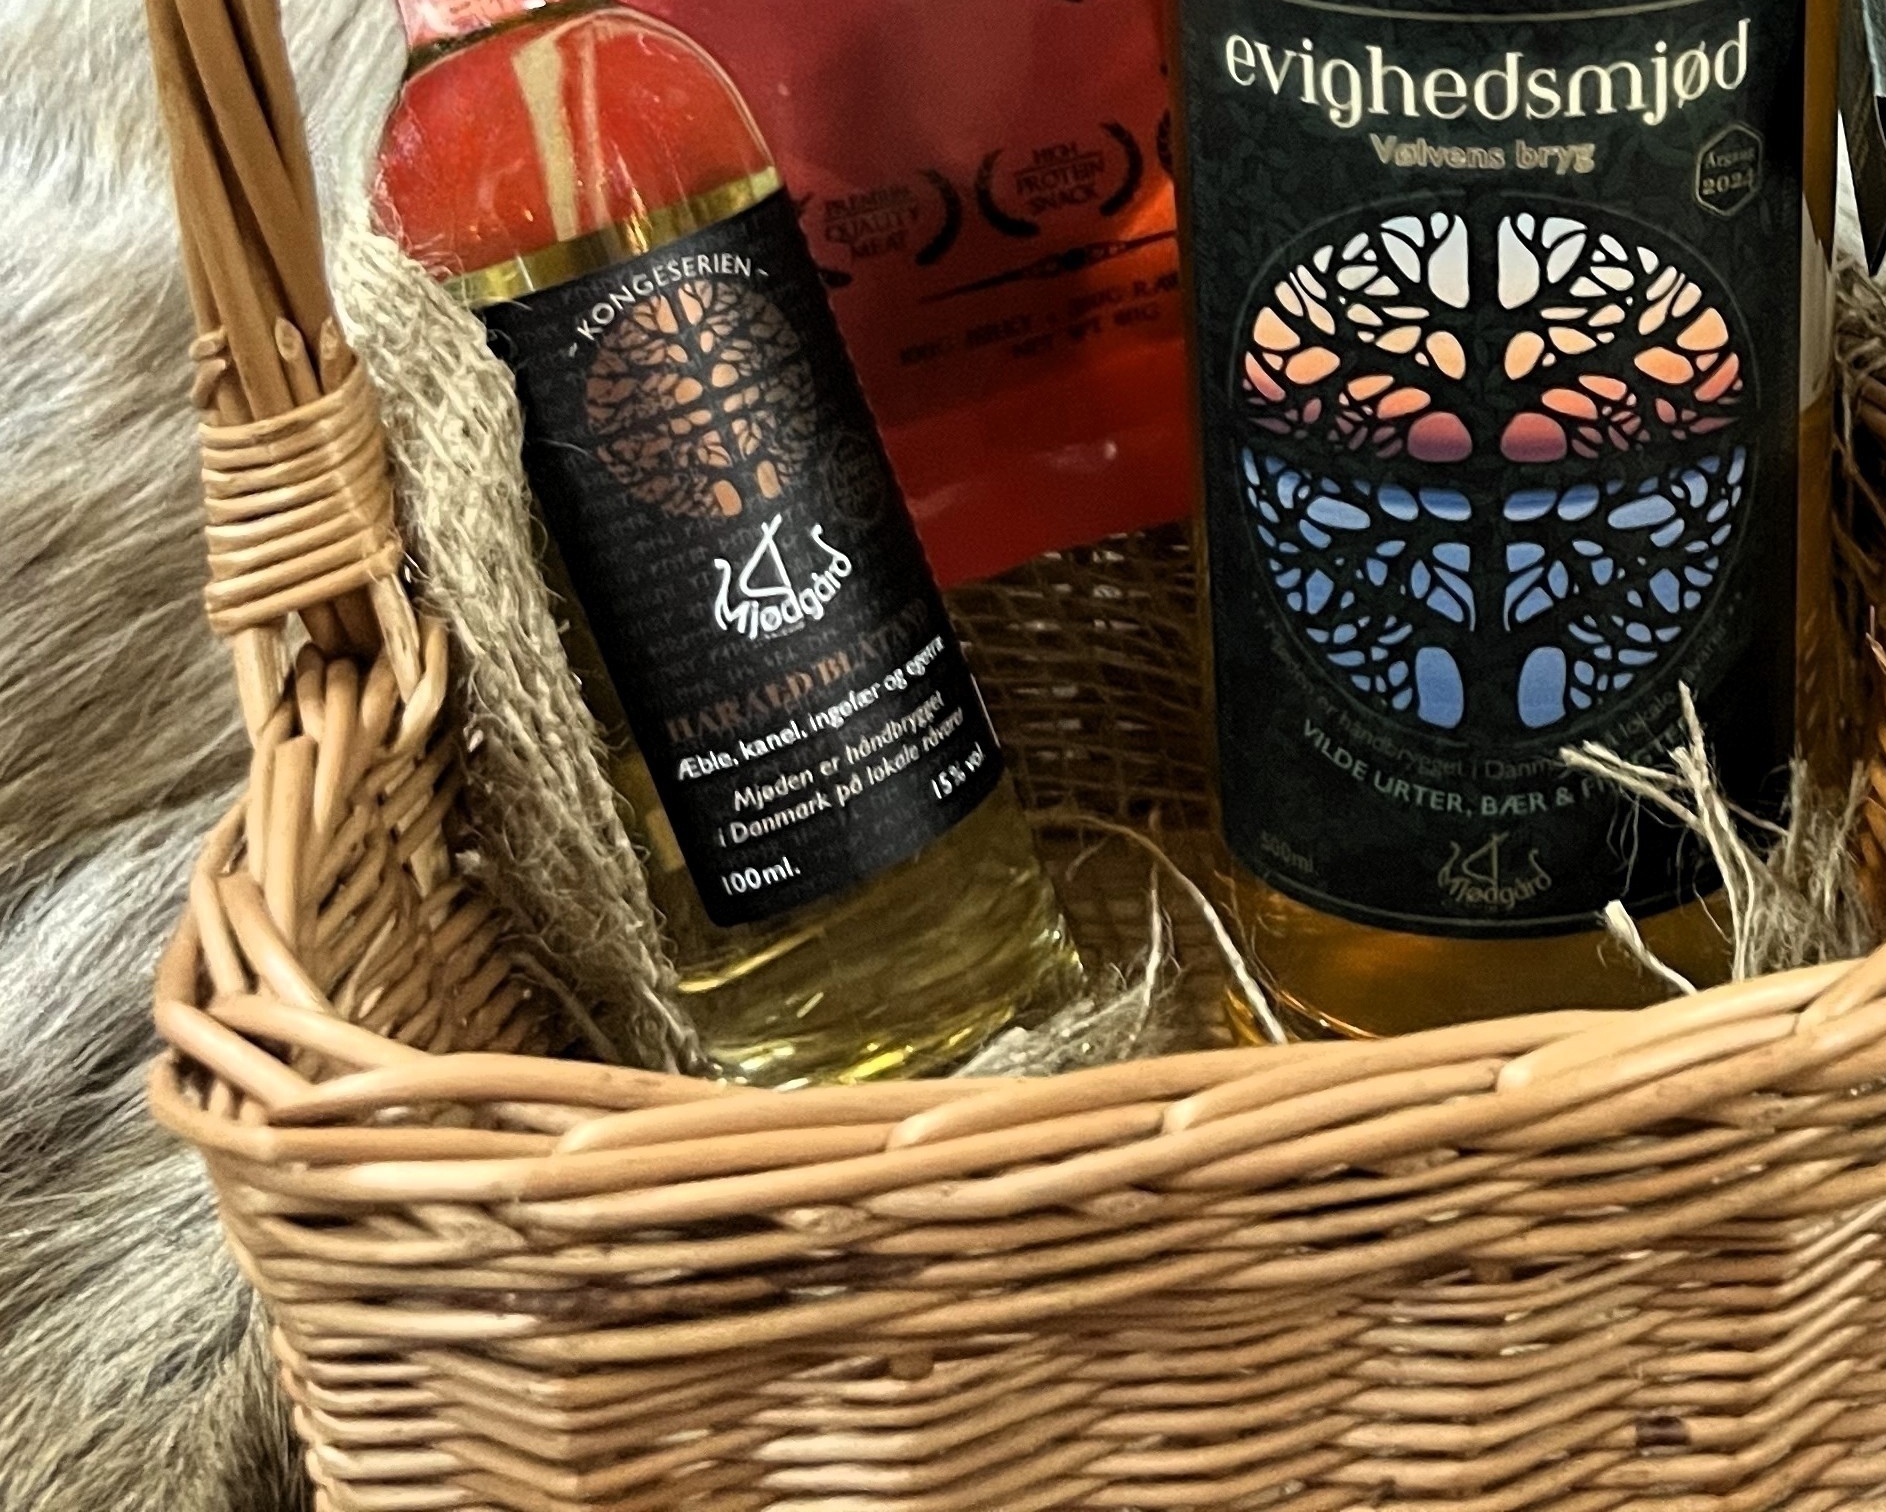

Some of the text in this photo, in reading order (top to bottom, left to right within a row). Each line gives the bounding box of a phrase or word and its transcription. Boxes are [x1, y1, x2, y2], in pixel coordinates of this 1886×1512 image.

[1225, 18, 1752, 129] evighedsmjød
[1367, 133, 1597, 176] Vølvens bryg
[1015, 159, 1106, 194] PROTEIN
[824, 204, 920, 243] QUALITY
[576, 252, 752, 342] KONGESERIEN
[884, 668, 908, 691] og
[733, 768, 814, 813] Mjøden
[820, 755, 841, 778] er
[930, 759, 967, 800] 15%
[1304, 717, 1369, 782] VILDE
[1373, 770, 1473, 818] URTER,
[1481, 791, 1547, 816] BÆR
[1556, 785, 1575, 807] &
[730, 790, 833, 845] Danmark
[836, 772, 863, 808] på
[866, 741, 920, 786] lokale
[720, 855, 801, 897] 100ml.
